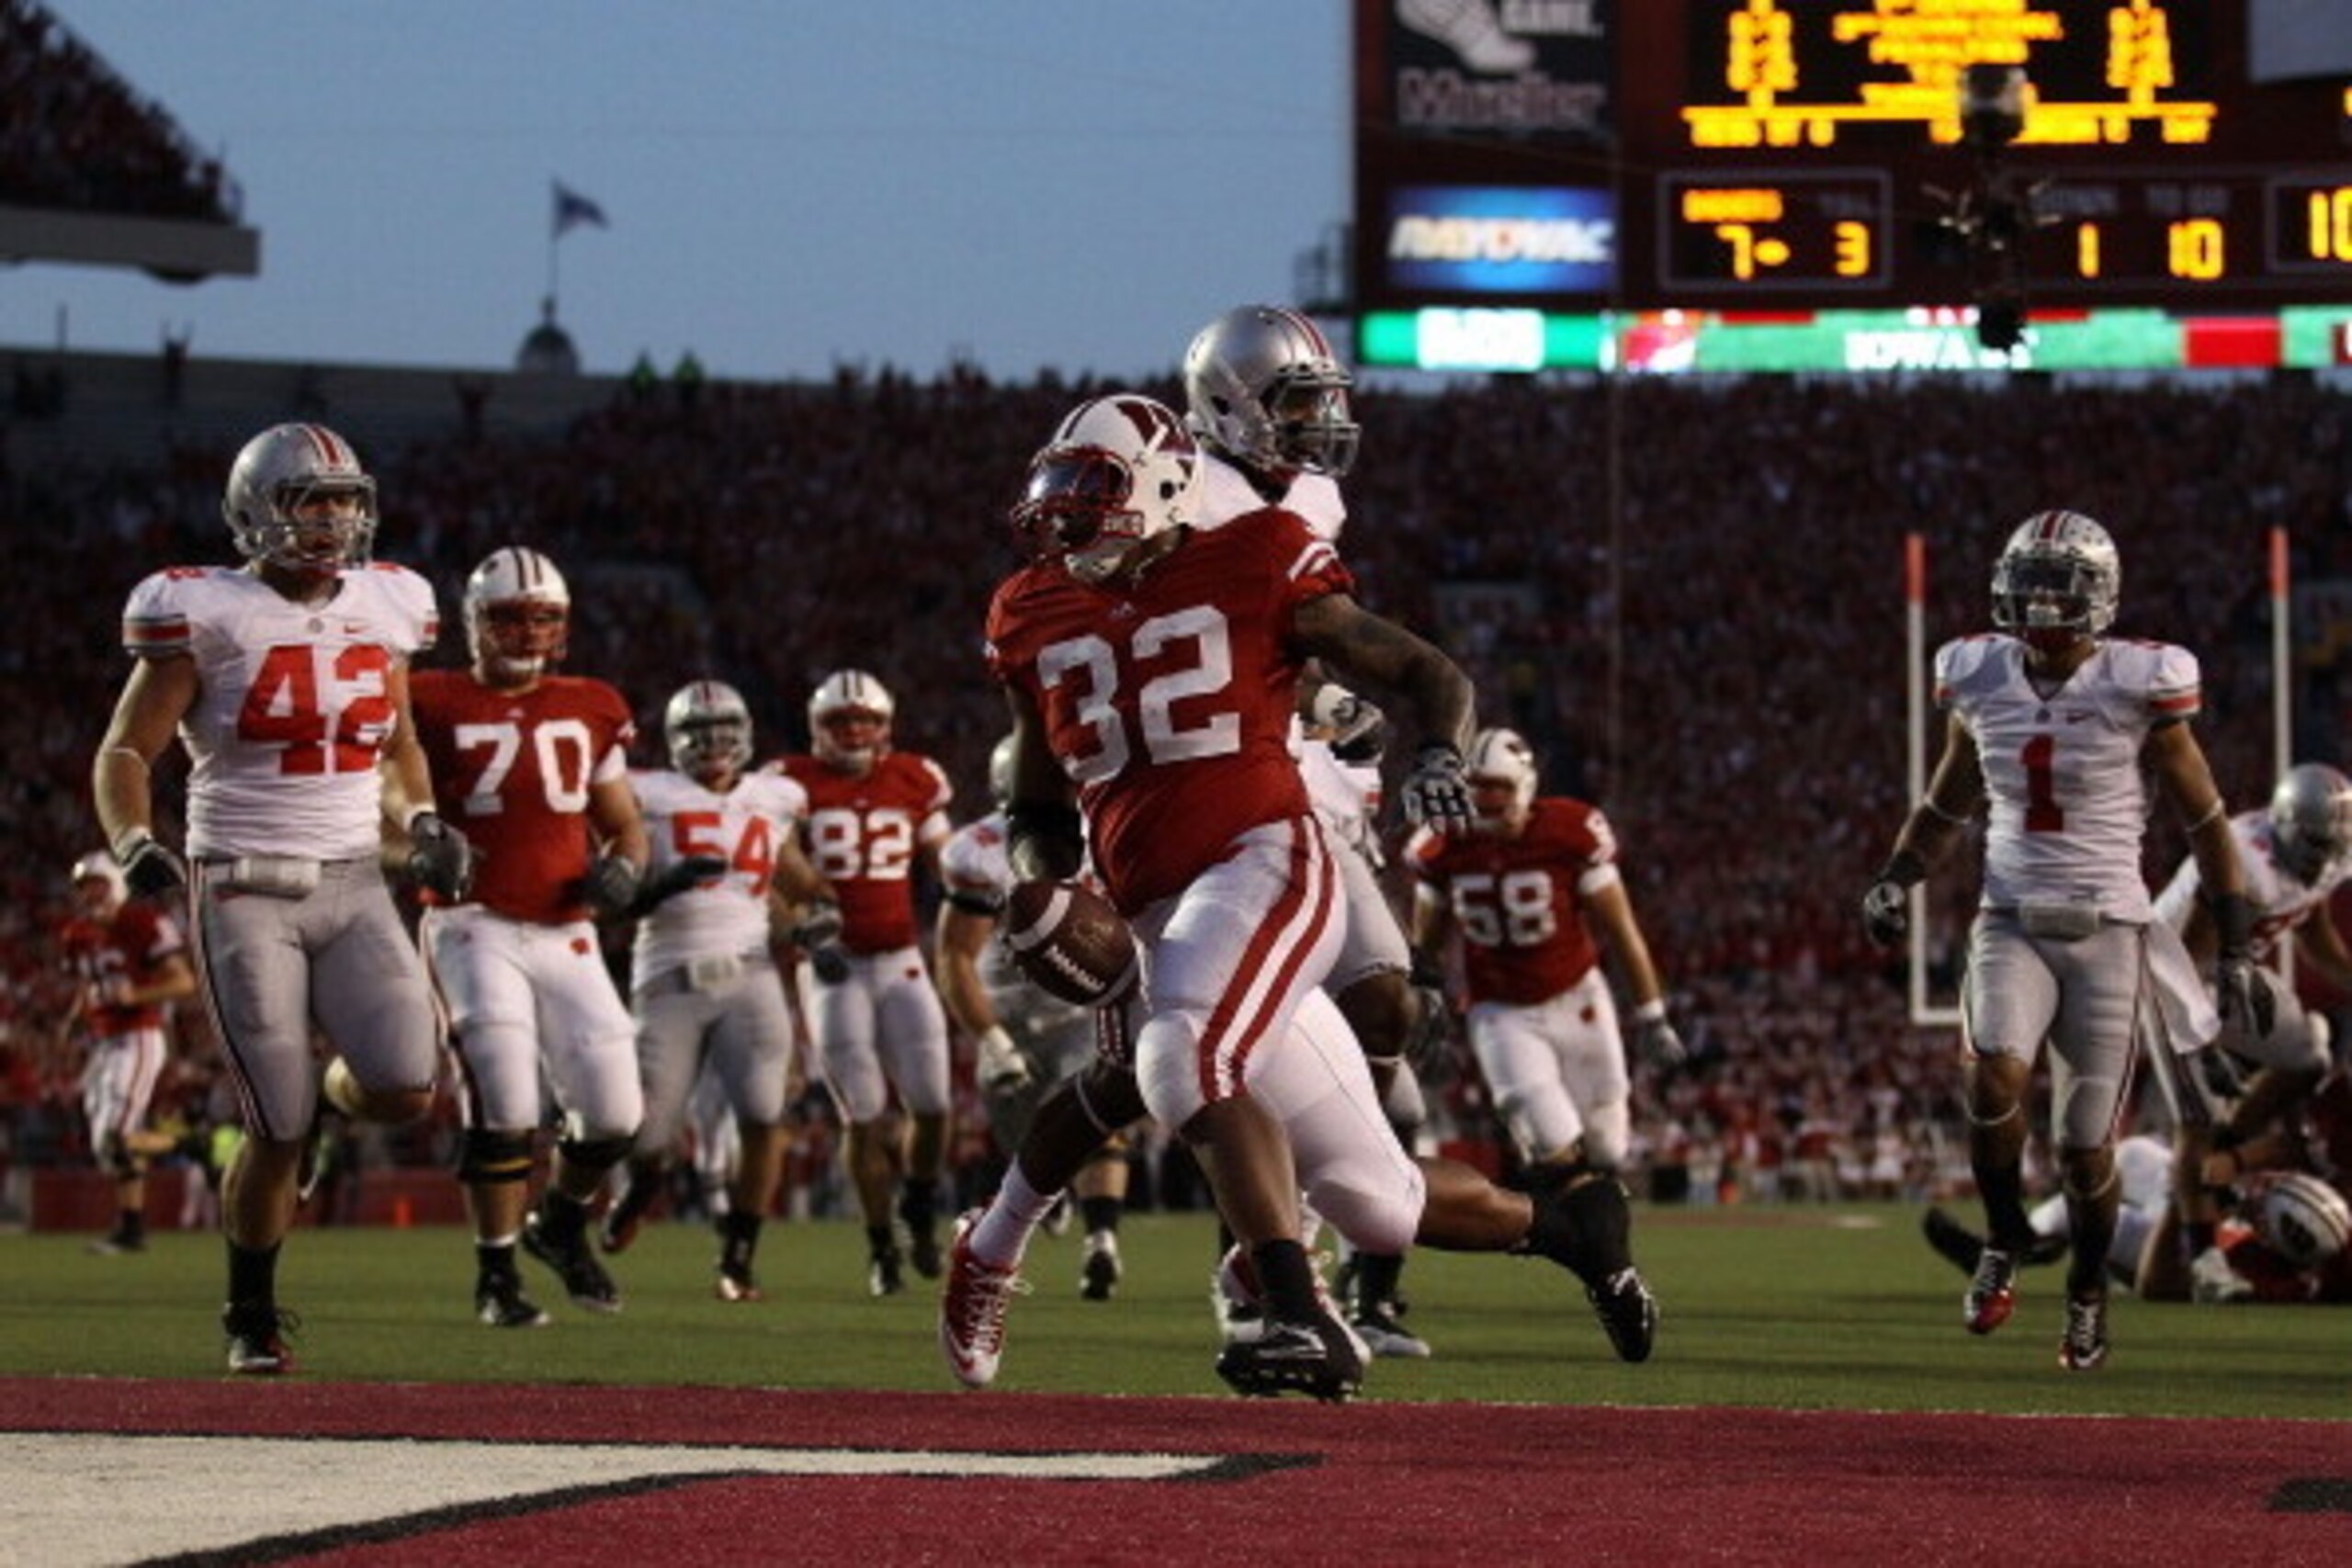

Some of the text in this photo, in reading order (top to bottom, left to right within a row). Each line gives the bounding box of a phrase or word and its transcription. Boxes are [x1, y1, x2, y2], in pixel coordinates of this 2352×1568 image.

[1716, 224, 1752, 279] 7
[1835, 221, 1869, 276] 3
[2079, 222, 2099, 276] 1
[2169, 220, 2222, 279] 10
[237, 644, 395, 774] 42
[1036, 604, 1240, 784] 32
[454, 719, 592, 814] 70
[2019, 734, 2064, 831] 1
[672, 811, 774, 897] 54
[812, 807, 911, 880] 82
[1452, 871, 1556, 946] 58
